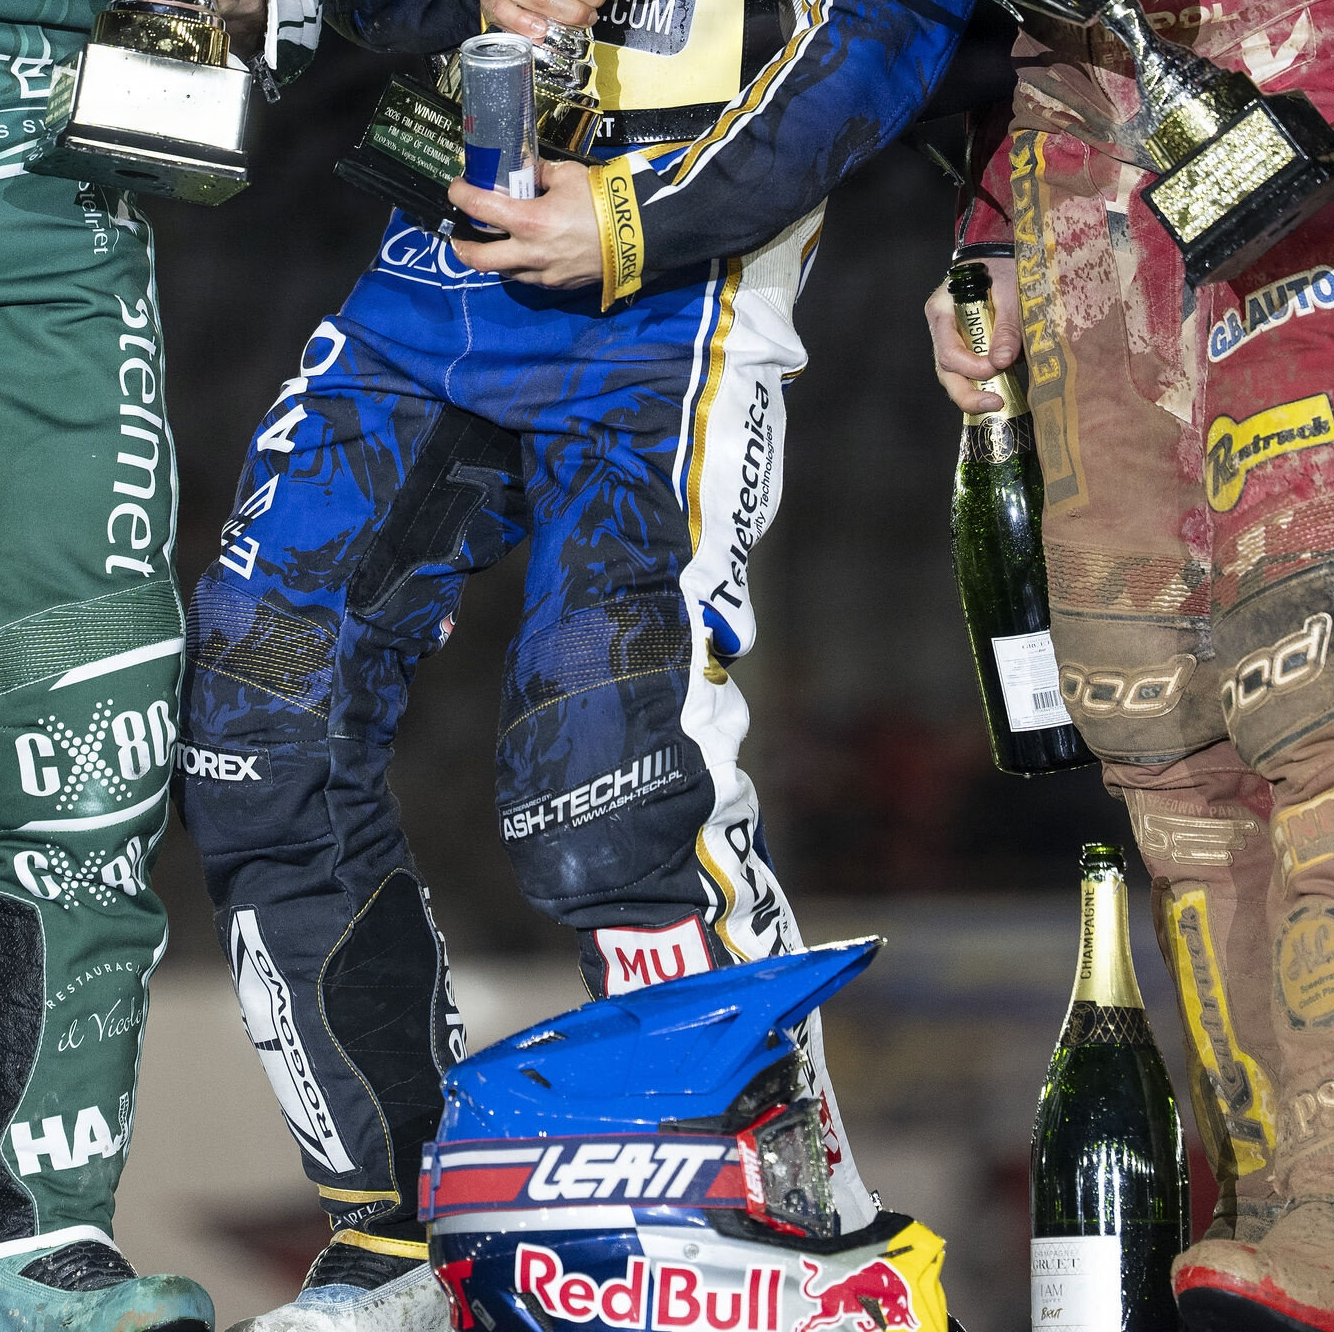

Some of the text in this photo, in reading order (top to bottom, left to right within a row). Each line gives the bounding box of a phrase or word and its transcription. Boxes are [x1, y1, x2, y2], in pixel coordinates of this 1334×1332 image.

[414, 101, 453, 131] WINNER
[413, 139, 424, 150] OF
[423, 145, 452, 167] DENMARK
[609, 175, 635, 286] GARCAREK
[1010, 142, 1061, 387] ENTRACK
[105, 293, 164, 579] Stelmet
[759, 425, 773, 508] Technologies
[177, 742, 262, 781] TOREX
[503, 760, 640, 841] ASH-TECH
[572, 770, 683, 828] WWW.ASH-TECH.PL
[1145, 793, 1203, 816] SPEEDWAY
[1080, 887, 1095, 980] CHAMPAGNE
[88, 996, 142, 1042] Vicolo
[527, 1142, 726, 1201] LEATT
[517, 1245, 783, 1328] Red Bull
[1045, 1283, 1063, 1297] AM
